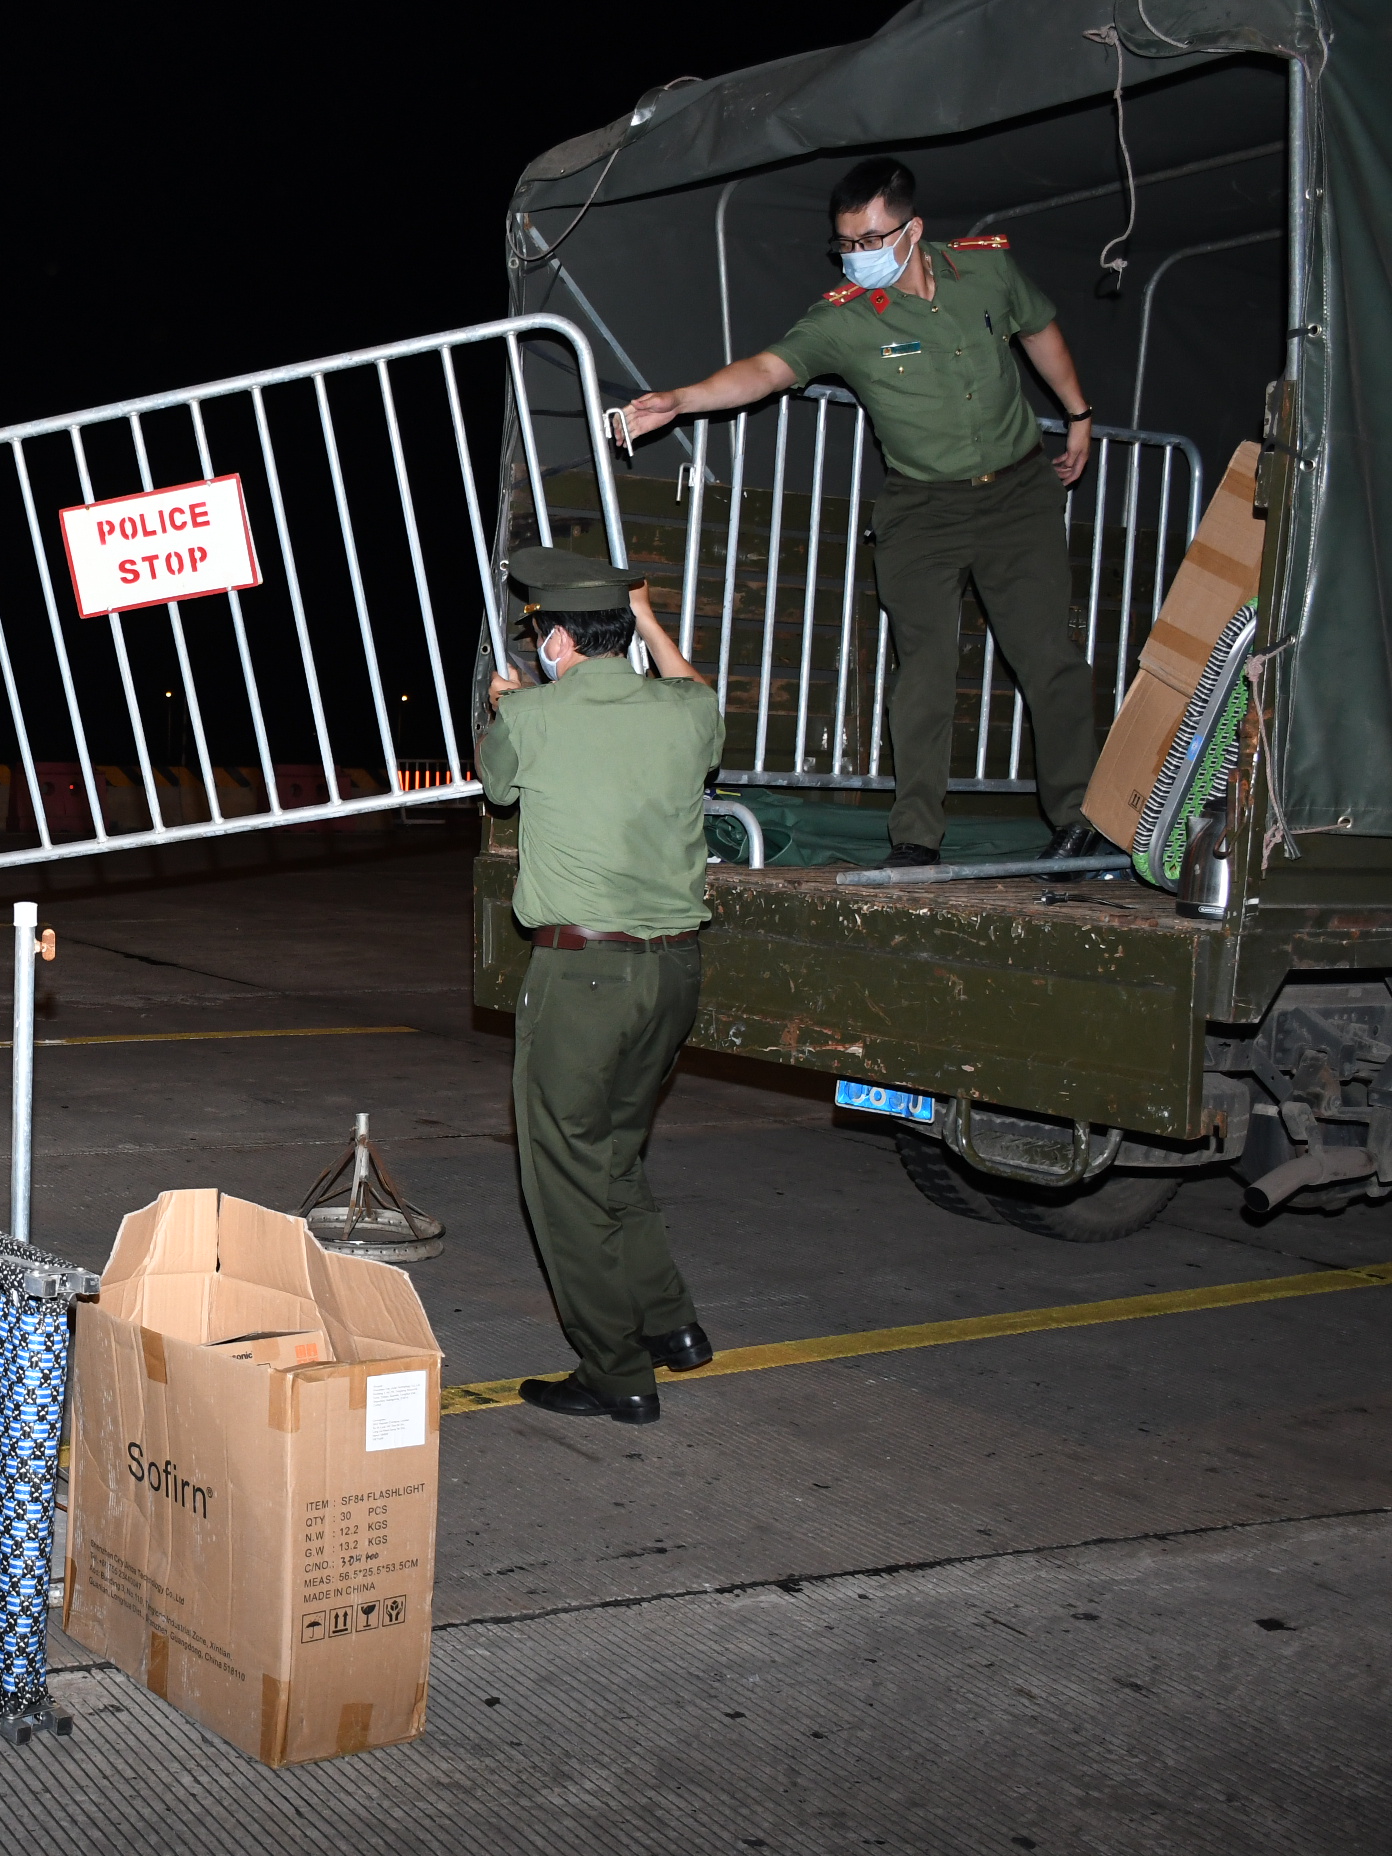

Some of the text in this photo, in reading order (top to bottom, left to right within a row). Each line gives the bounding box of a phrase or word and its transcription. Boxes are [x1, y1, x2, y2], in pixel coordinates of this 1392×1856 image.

[96, 501, 211, 545] POLICE
[118, 546, 208, 584] STOP
[306, 1500, 329, 1512] ITEM
[341, 1494, 365, 1506] SF84
[367, 1483, 426, 1502] FLASHLIGHT
[305, 1515, 325, 1527] QTY
[340, 1511, 352, 1521] 30
[368, 1505, 388, 1516] PCS
[340, 1525, 359, 1536] 12.2
[368, 1520, 388, 1531] KGS
[339, 1540, 359, 1551] 13.2
[368, 1535, 388, 1546] KGS
[303, 1582, 376, 1603] MADE IN CHINA
[204, 1652, 222, 1669] China
